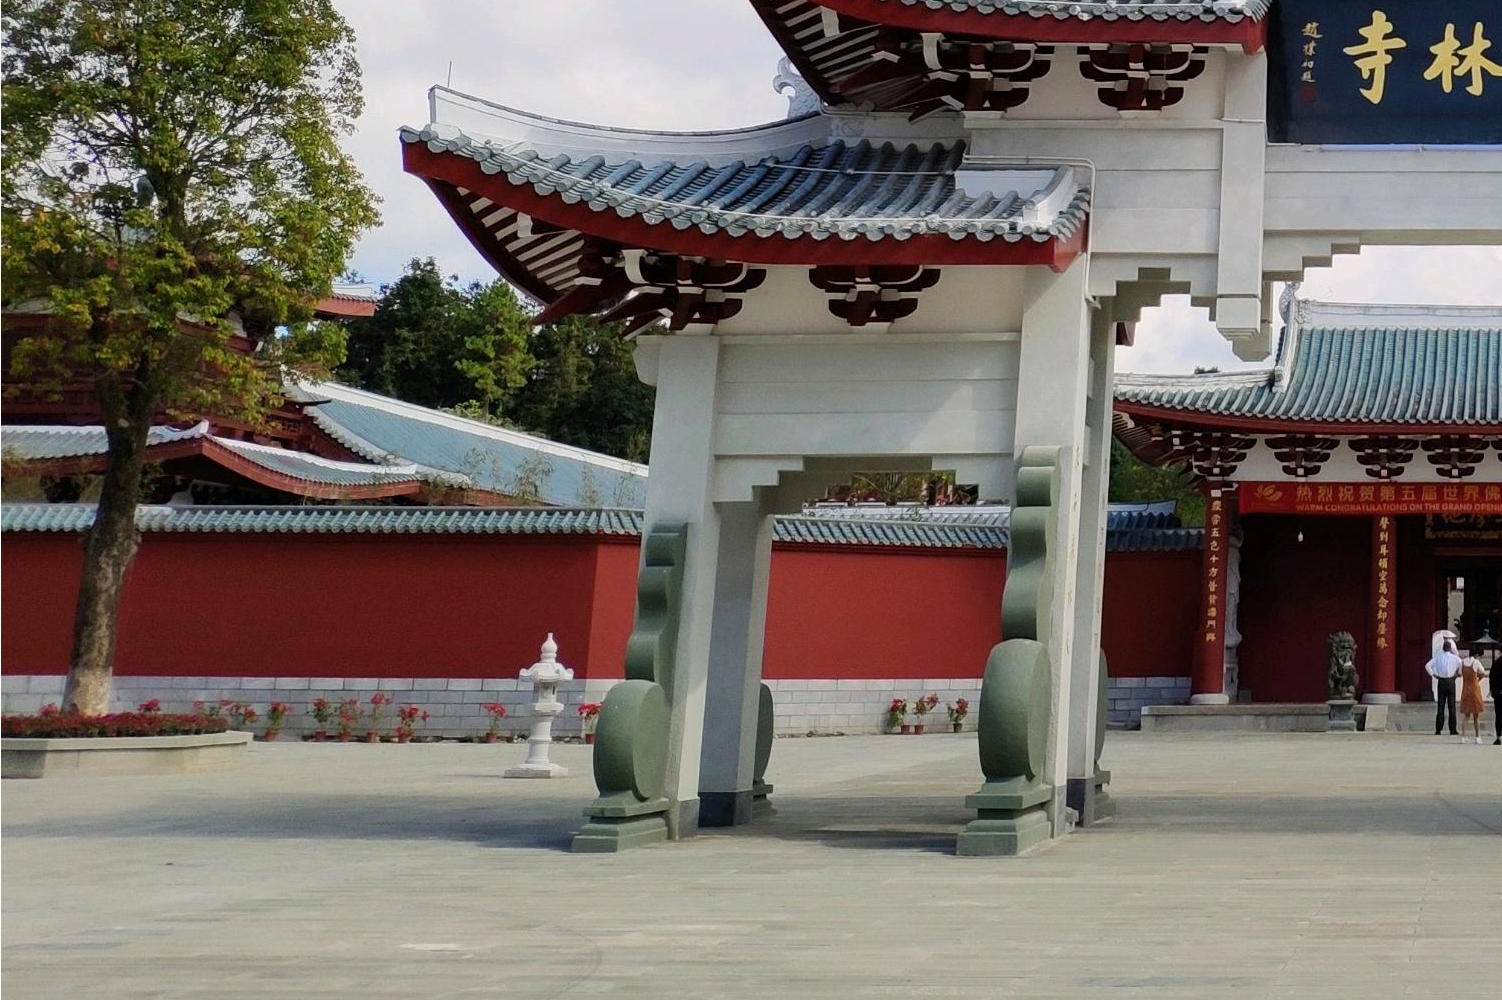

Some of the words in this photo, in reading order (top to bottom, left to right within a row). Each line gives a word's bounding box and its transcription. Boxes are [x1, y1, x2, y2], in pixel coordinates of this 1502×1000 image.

[1296, 503, 1323, 513] WARM
[1325, 503, 1408, 513] CONGRATULATIONS
[1409, 503, 1423, 513] ON
[1424, 503, 1440, 513] THE
[1441, 503, 1473, 513] GRAND
